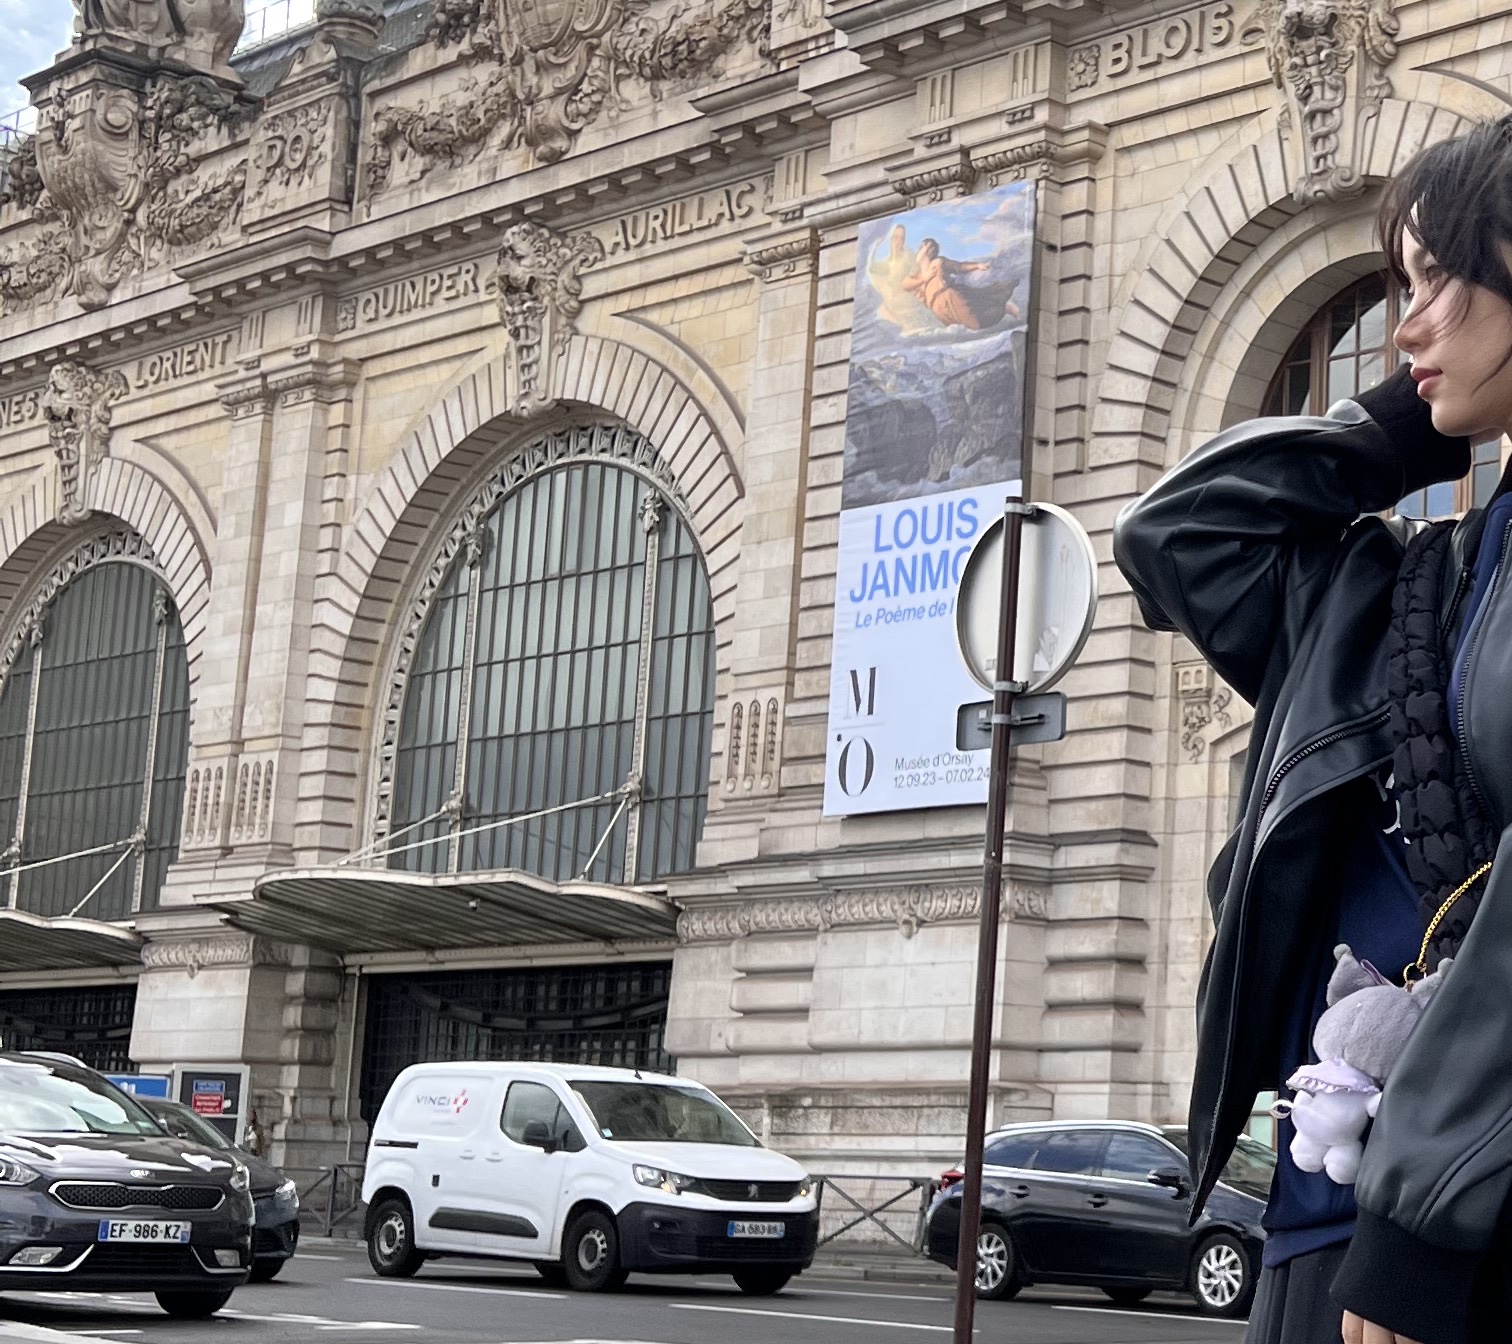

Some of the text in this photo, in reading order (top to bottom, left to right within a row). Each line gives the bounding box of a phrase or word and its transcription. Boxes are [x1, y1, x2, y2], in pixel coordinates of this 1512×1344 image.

[1106, 2, 1235, 78] BLOIS
[262, 126, 314, 181] PO
[608, 182, 756, 255] AURILLAC
[361, 262, 480, 323] QUIMPER
[133, 333, 233, 391] LORIENT
[874, 497, 979, 553] LOUIS
[855, 611, 873, 629] Le
[874, 604, 926, 626] Poème
[928, 599, 947, 615] de
[894, 752, 975, 771] Musée d'Orsay
